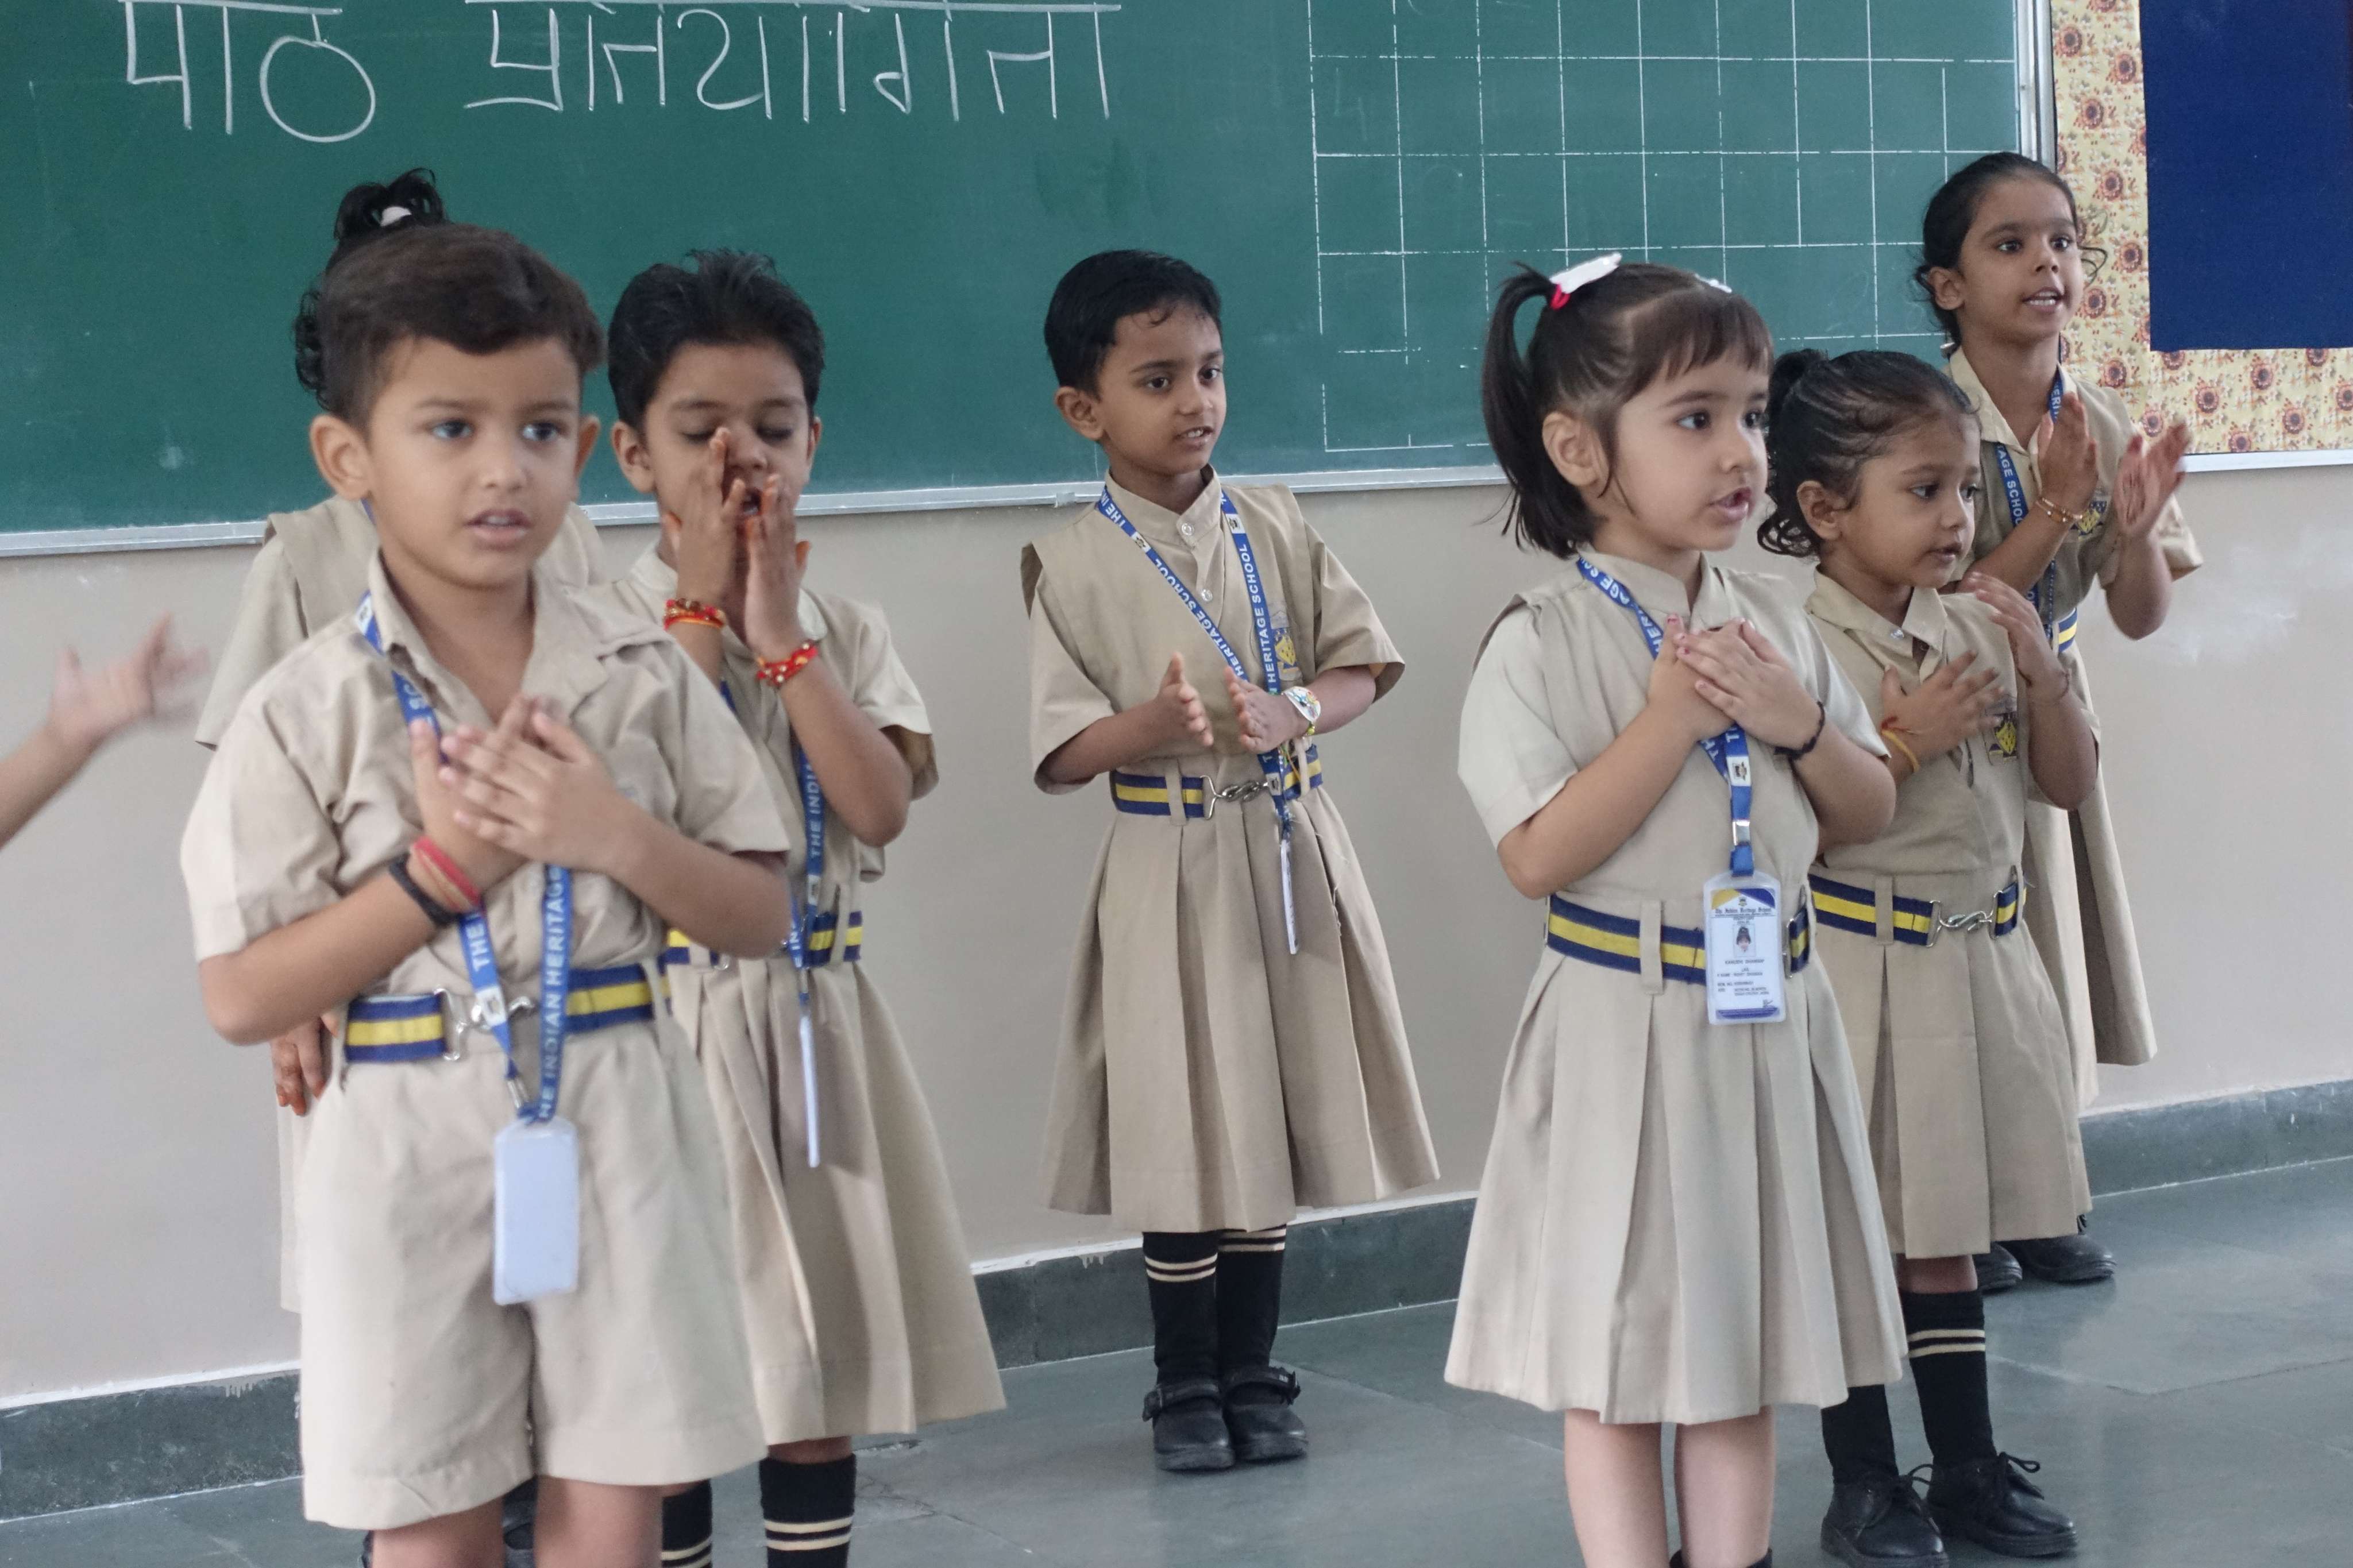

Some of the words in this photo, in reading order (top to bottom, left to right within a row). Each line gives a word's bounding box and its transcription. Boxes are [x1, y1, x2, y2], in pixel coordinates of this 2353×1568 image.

[1239, 544, 1262, 603] SCHOOL
[1196, 610, 1244, 676] HERITAGE
[1255, 607, 1277, 683] HERITAGE
[809, 820, 821, 858] THE
[465, 922, 491, 972] THE
[543, 993, 562, 1079] INDIAN
